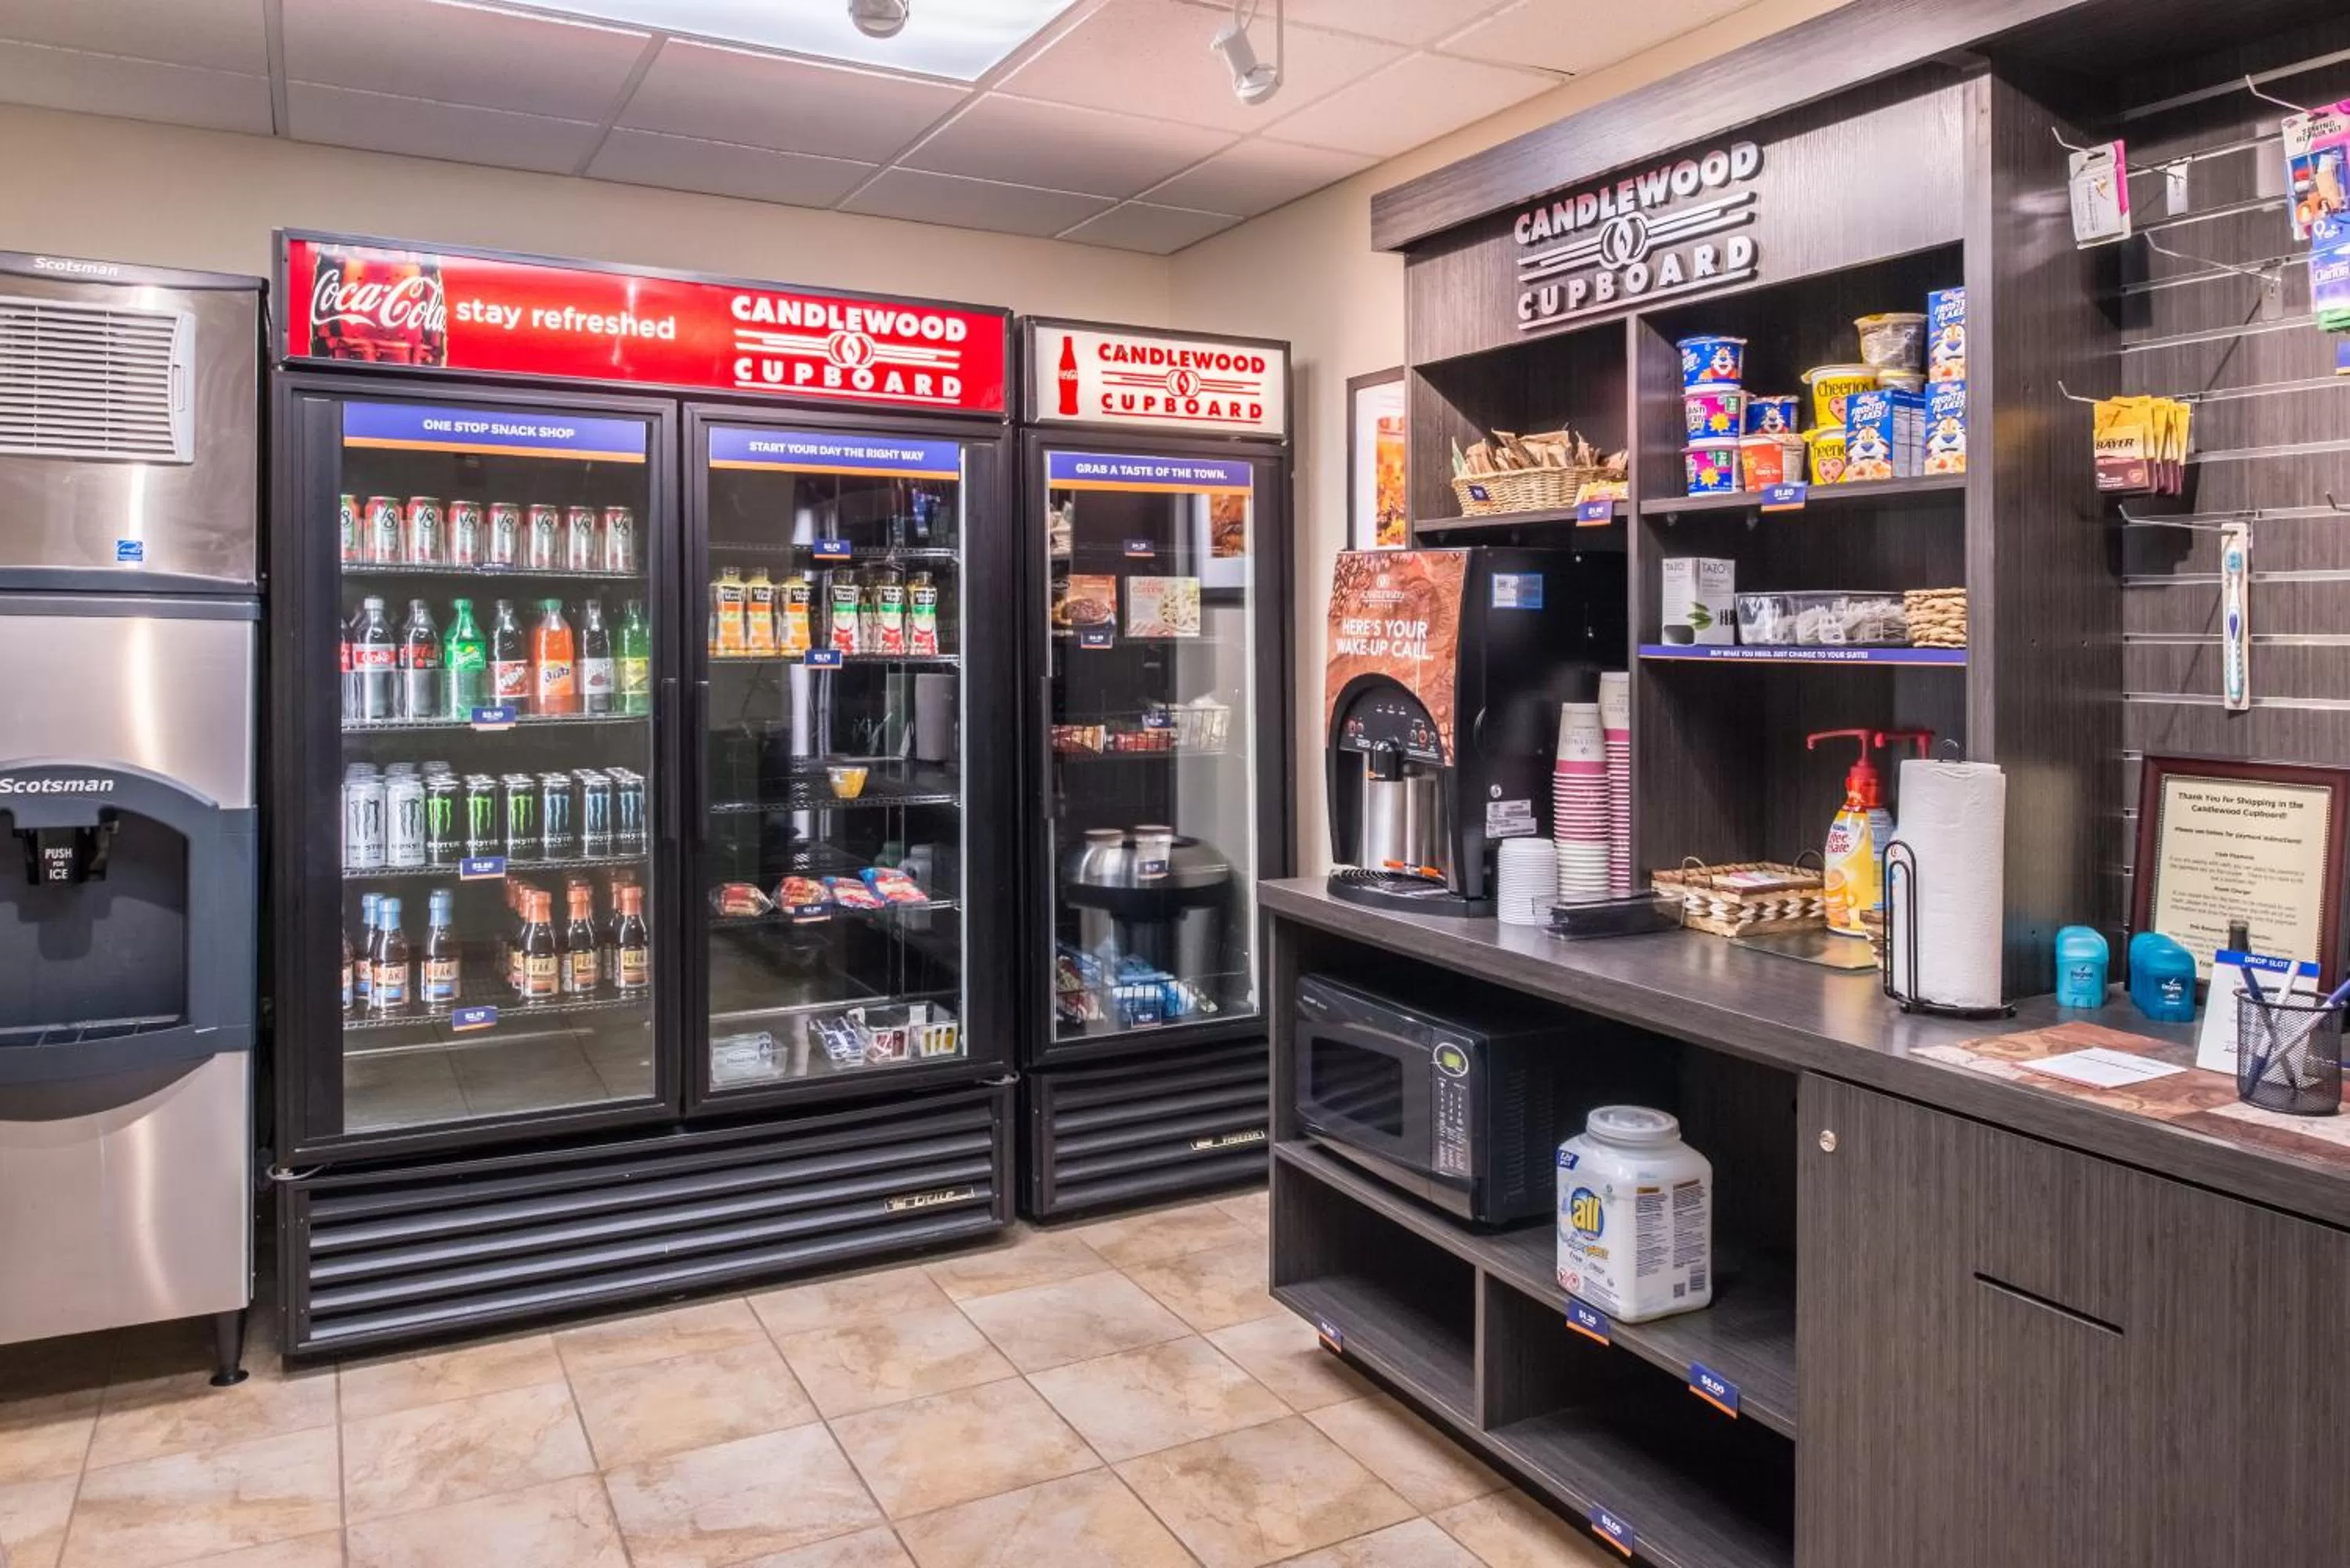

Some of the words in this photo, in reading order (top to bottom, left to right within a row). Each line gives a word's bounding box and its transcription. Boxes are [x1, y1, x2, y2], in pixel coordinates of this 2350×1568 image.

[1514, 141, 1759, 244] CANDLEWOOD
[34, 257, 119, 277] Scotsman
[1518, 236, 1753, 320] CUPBOARD
[311, 269, 446, 332] Coca-Cola
[457, 299, 522, 330] stay
[532, 305, 676, 340] refreshed
[731, 294, 967, 342] CANDLEWOOD
[1098, 343, 1265, 374] CANDLEWOOD
[734, 359, 962, 398] CUPBOARD
[1101, 393, 1262, 419] CUPBOARD
[423, 419, 451, 432] ONE
[454, 421, 489, 433] STOP
[491, 424, 537, 437] SNACK
[539, 426, 575, 439] SHOP
[749, 442, 786, 453] START
[788, 443, 818, 454] YOUR
[819, 446, 843, 457] DAY
[844, 446, 864, 457] THE
[866, 448, 899, 460] RIGHT
[902, 450, 924, 461] WAY
[2096, 438, 2135, 450] BAYER
[1076, 463, 1108, 475] GRAB
[1110, 465, 1118, 475] A
[1121, 466, 1153, 477] TASTE
[1155, 468, 1170, 477] OF
[1173, 468, 1191, 478] THE
[1194, 469, 1227, 479] TOWN.
[418, 507, 436, 528] V8
[459, 511, 477, 530] V8
[497, 513, 514, 533] V8
[536, 513, 553, 533] V8
[573, 514, 591, 534] V8
[613, 514, 629, 537] V8
[1701, 562, 1725, 573] TAZO
[1342, 619, 1381, 637] HERE'S
[1385, 620, 1428, 639] YOUR
[1336, 638, 1388, 656] WAKE-UP
[1391, 640, 1434, 660] CALL.
[0, 779, 114, 793] Scotsman
[2178, 792, 2203, 801] Thank
[2206, 794, 2220, 803] You
[2236, 797, 2275, 808] Shopping
[2191, 804, 2241, 815] Candlewood
[45, 848, 73, 860] PUSH
[49, 869, 68, 880] ICE
[2244, 956, 2267, 964] DROP
[1572, 1196, 1600, 1232] all
